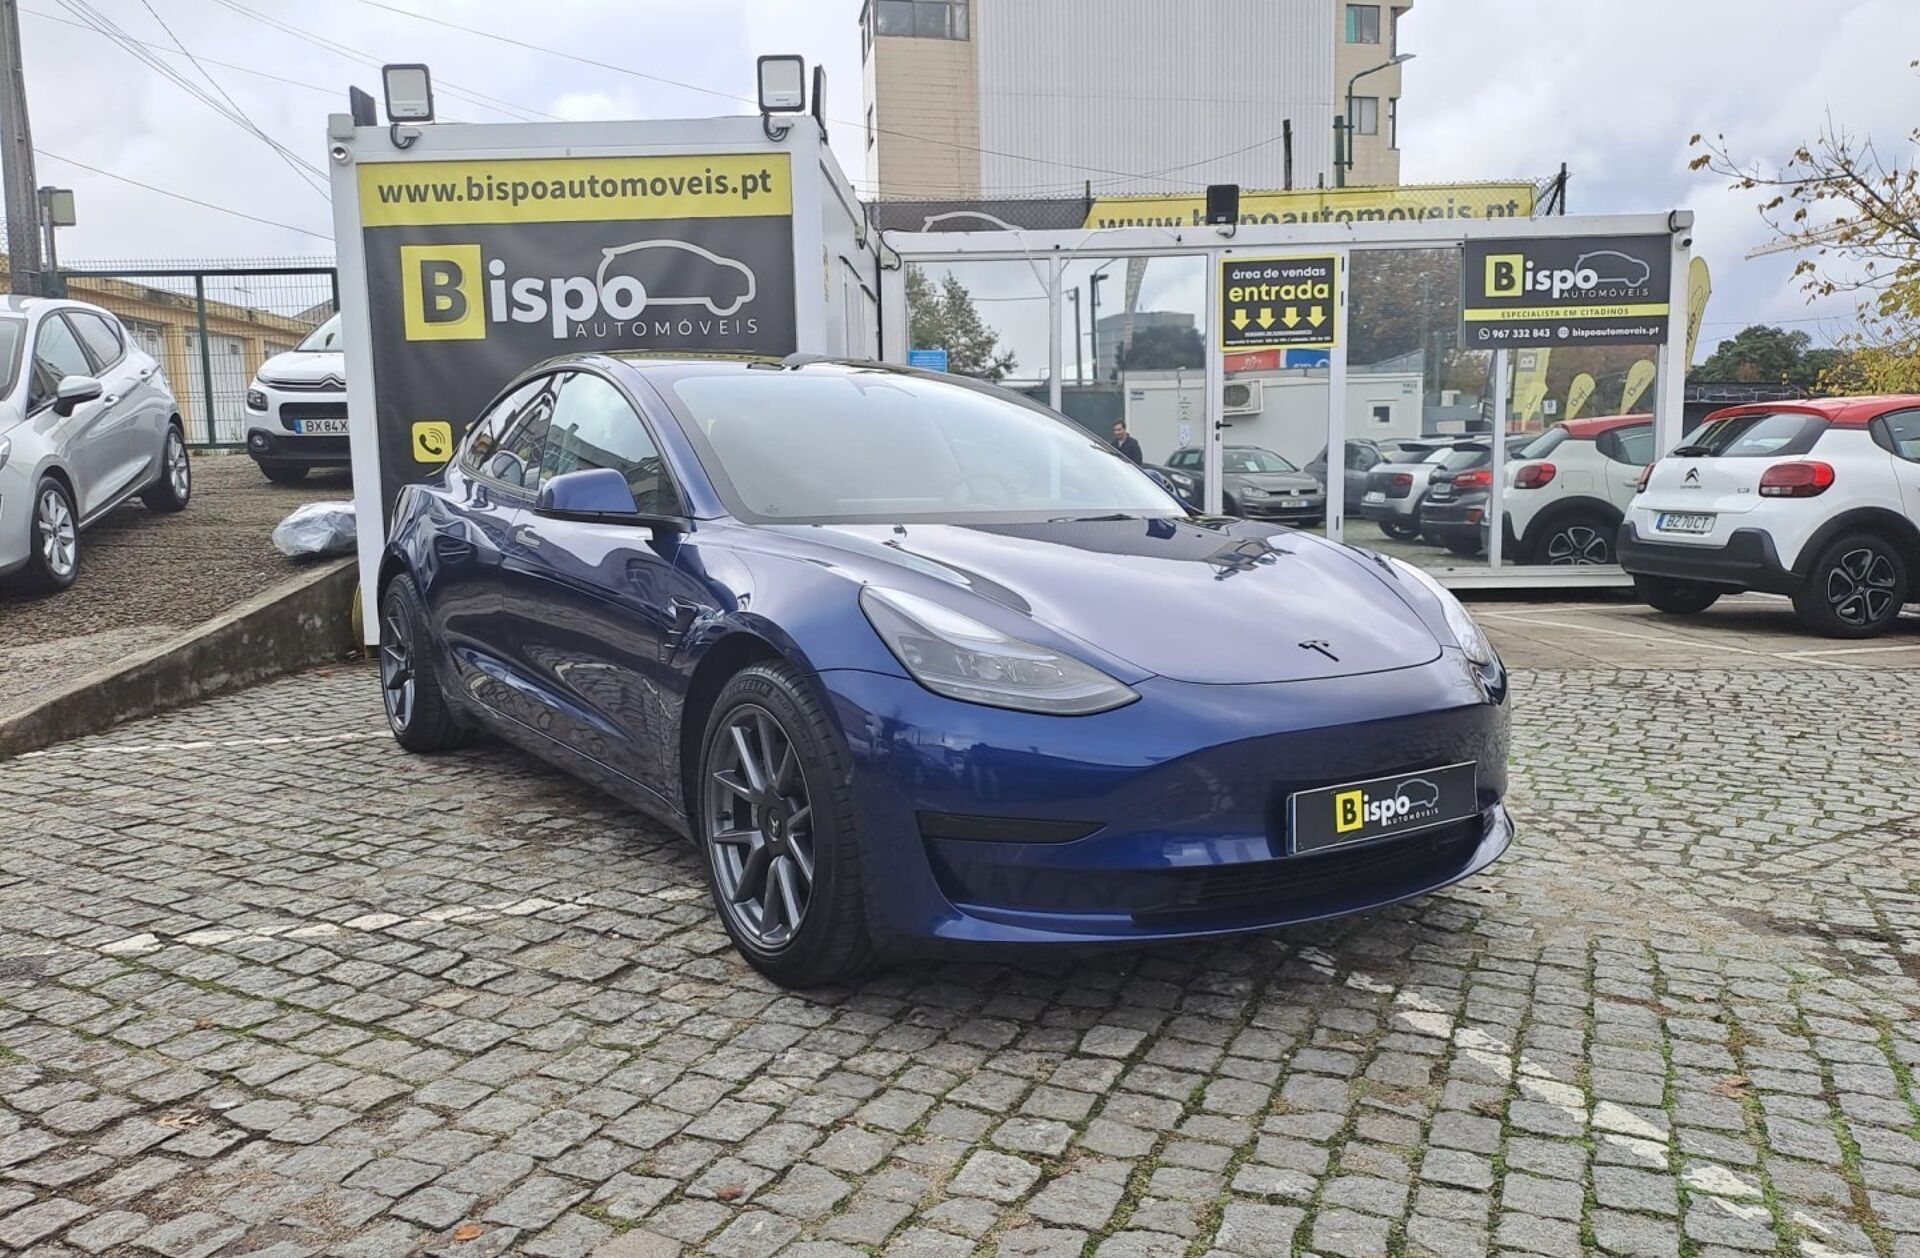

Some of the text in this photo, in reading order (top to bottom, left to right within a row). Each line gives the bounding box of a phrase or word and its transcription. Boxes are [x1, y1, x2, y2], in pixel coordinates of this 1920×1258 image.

[378, 168, 771, 206] www.bispoautomoveis.pt
[1232, 266, 1327, 280] área de vendas
[1494, 260, 1598, 299] Bispo
[420, 258, 647, 339] Bispo
[1228, 280, 1329, 302] entrada
[1561, 287, 1649, 299] AUTOMÓVEIS
[1501, 307, 1629, 319] ESPECIALISTA EM CITADINOS
[576, 318, 758, 337] AUTOMÓVEIS
[1492, 328, 1550, 339] 967 332 843
[1572, 325, 1660, 338] bispoautomoveis.pt
[306, 420, 348, 432] BX84X
[1342, 793, 1410, 827] Bispo
[1387, 808, 1440, 825] AUTOMÓVEIS
